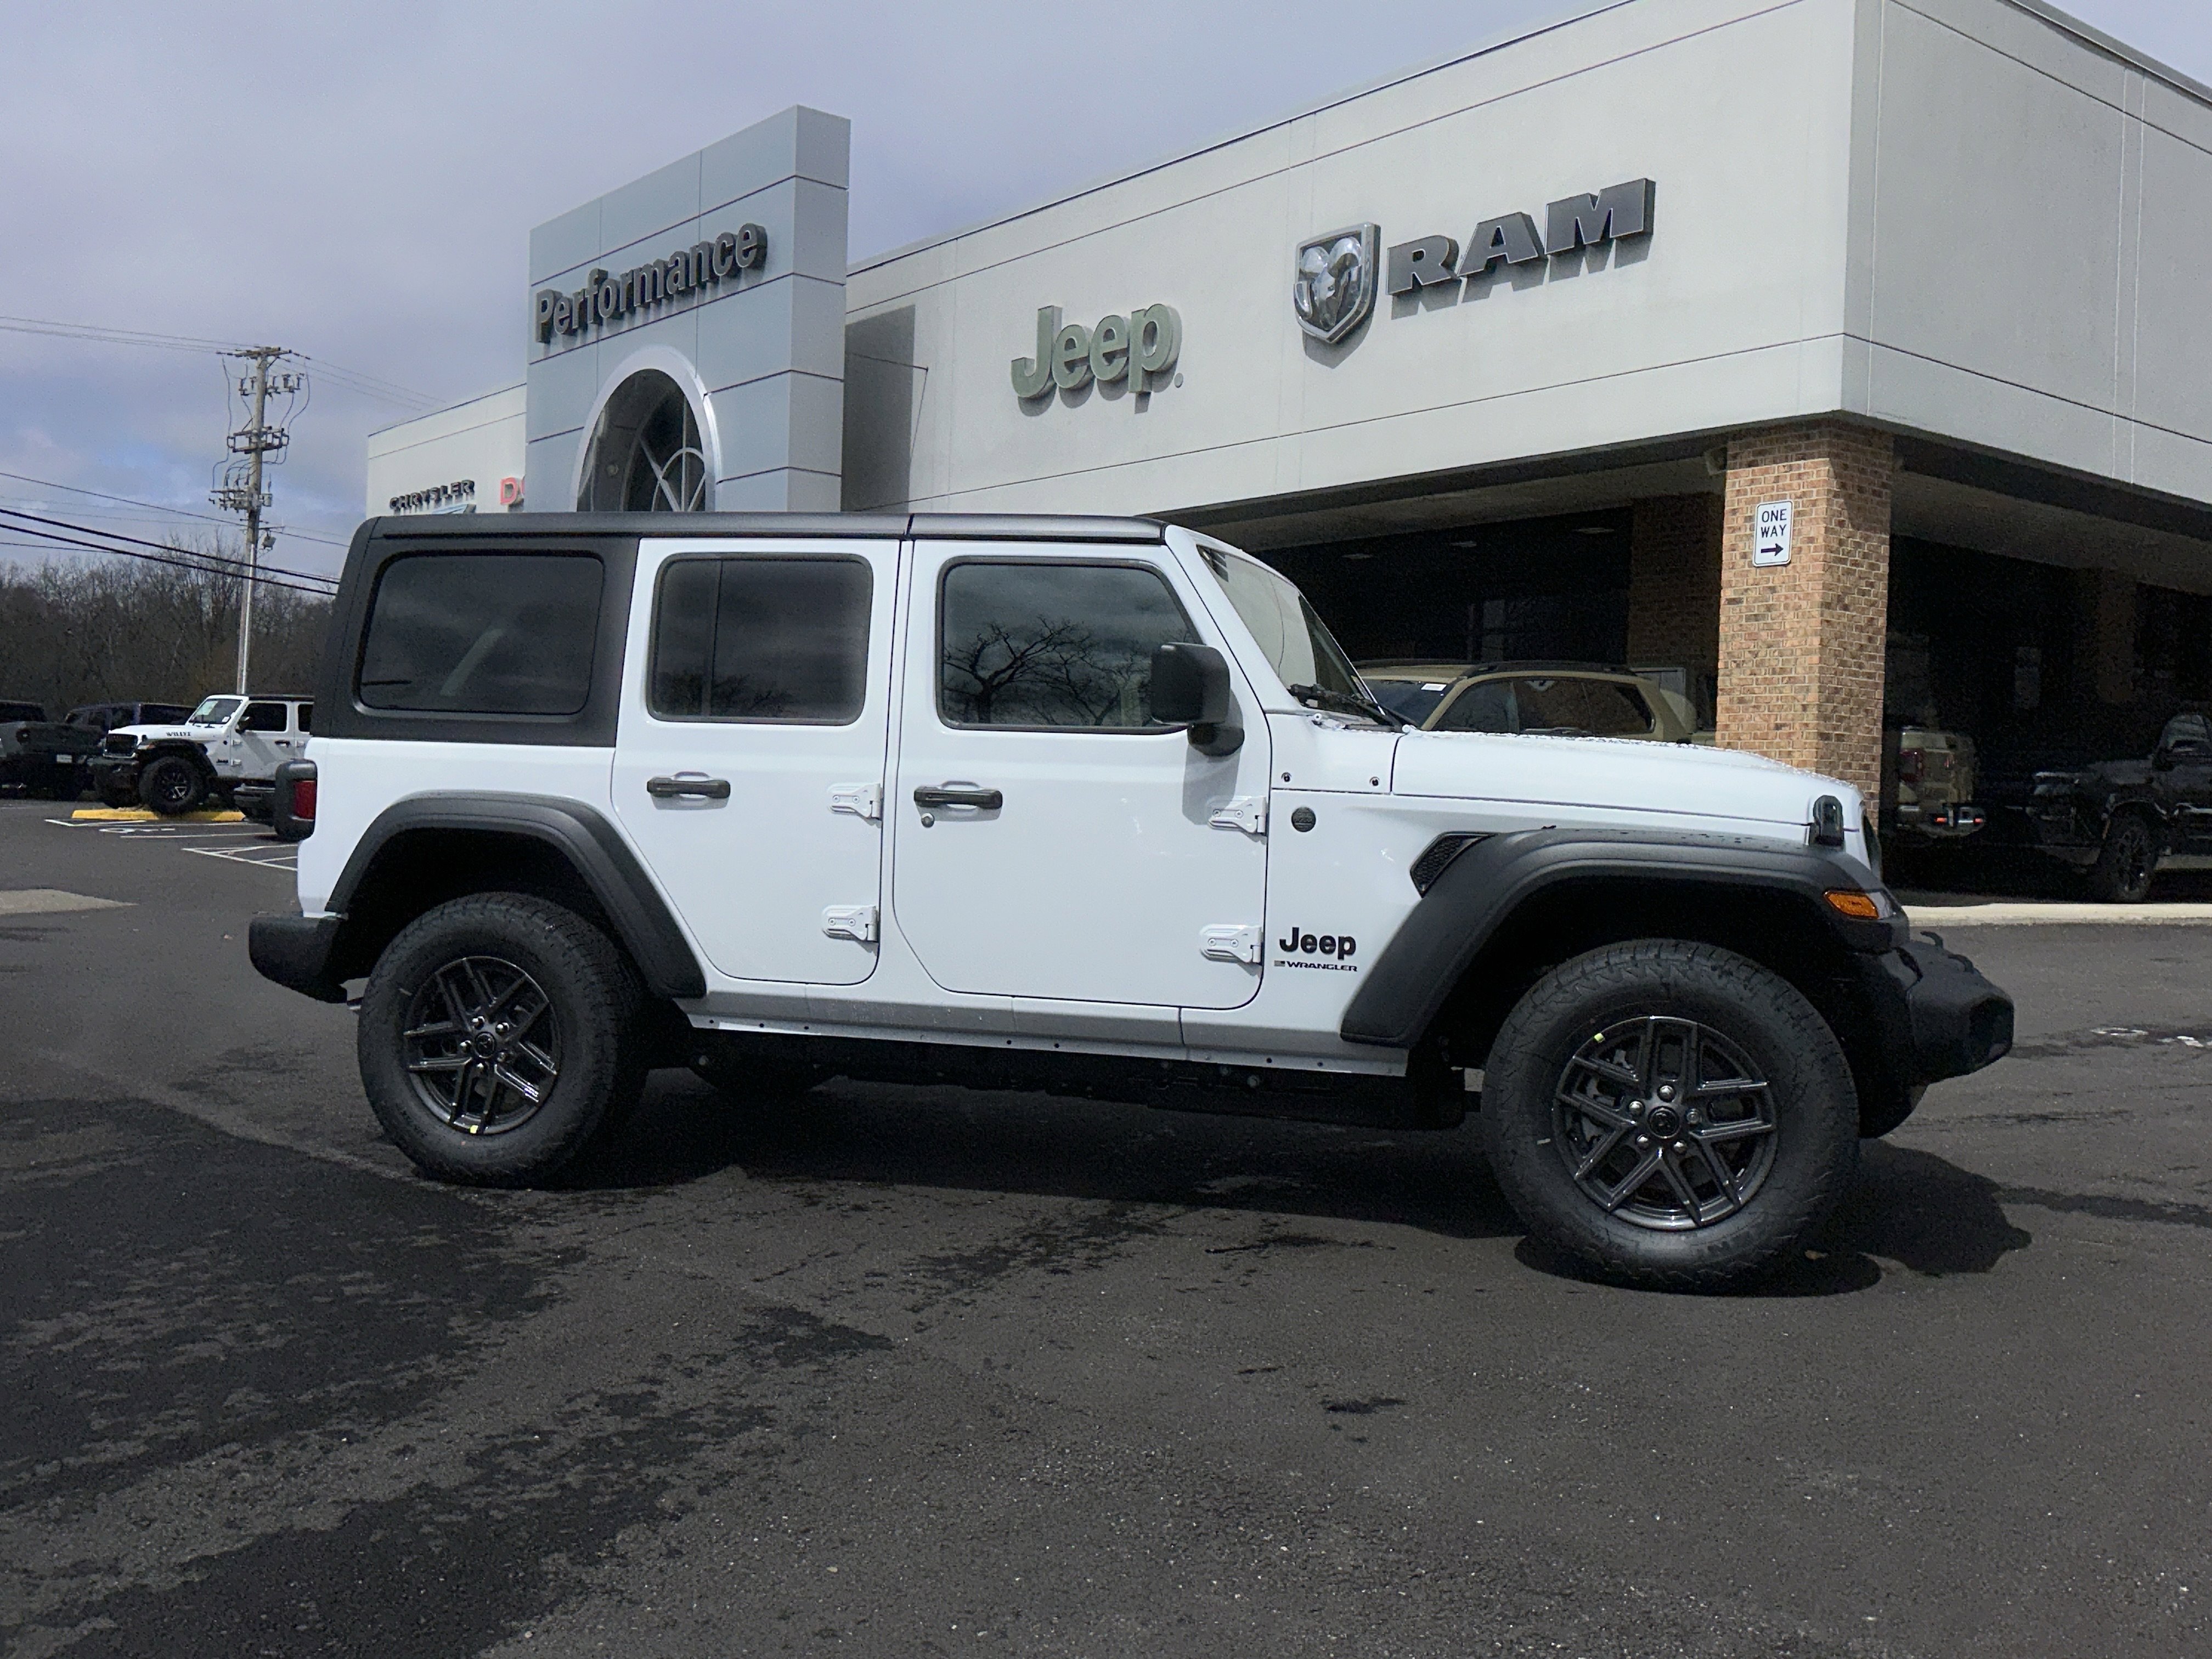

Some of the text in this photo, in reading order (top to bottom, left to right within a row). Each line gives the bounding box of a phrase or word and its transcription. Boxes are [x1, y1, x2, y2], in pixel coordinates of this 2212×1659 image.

[1386, 178, 1656, 295] RAM
[535, 223, 768, 343] Performance
[1011, 303, 1182, 393] Jeep
[390, 479, 475, 510] CHRYSLER
[500, 476, 525, 505] D
[1760, 524, 1787, 538] WAY
[1762, 509, 1787, 522] ONE
[1279, 927, 1356, 961] Jeep
[1286, 961, 1358, 972] WRANGLER
